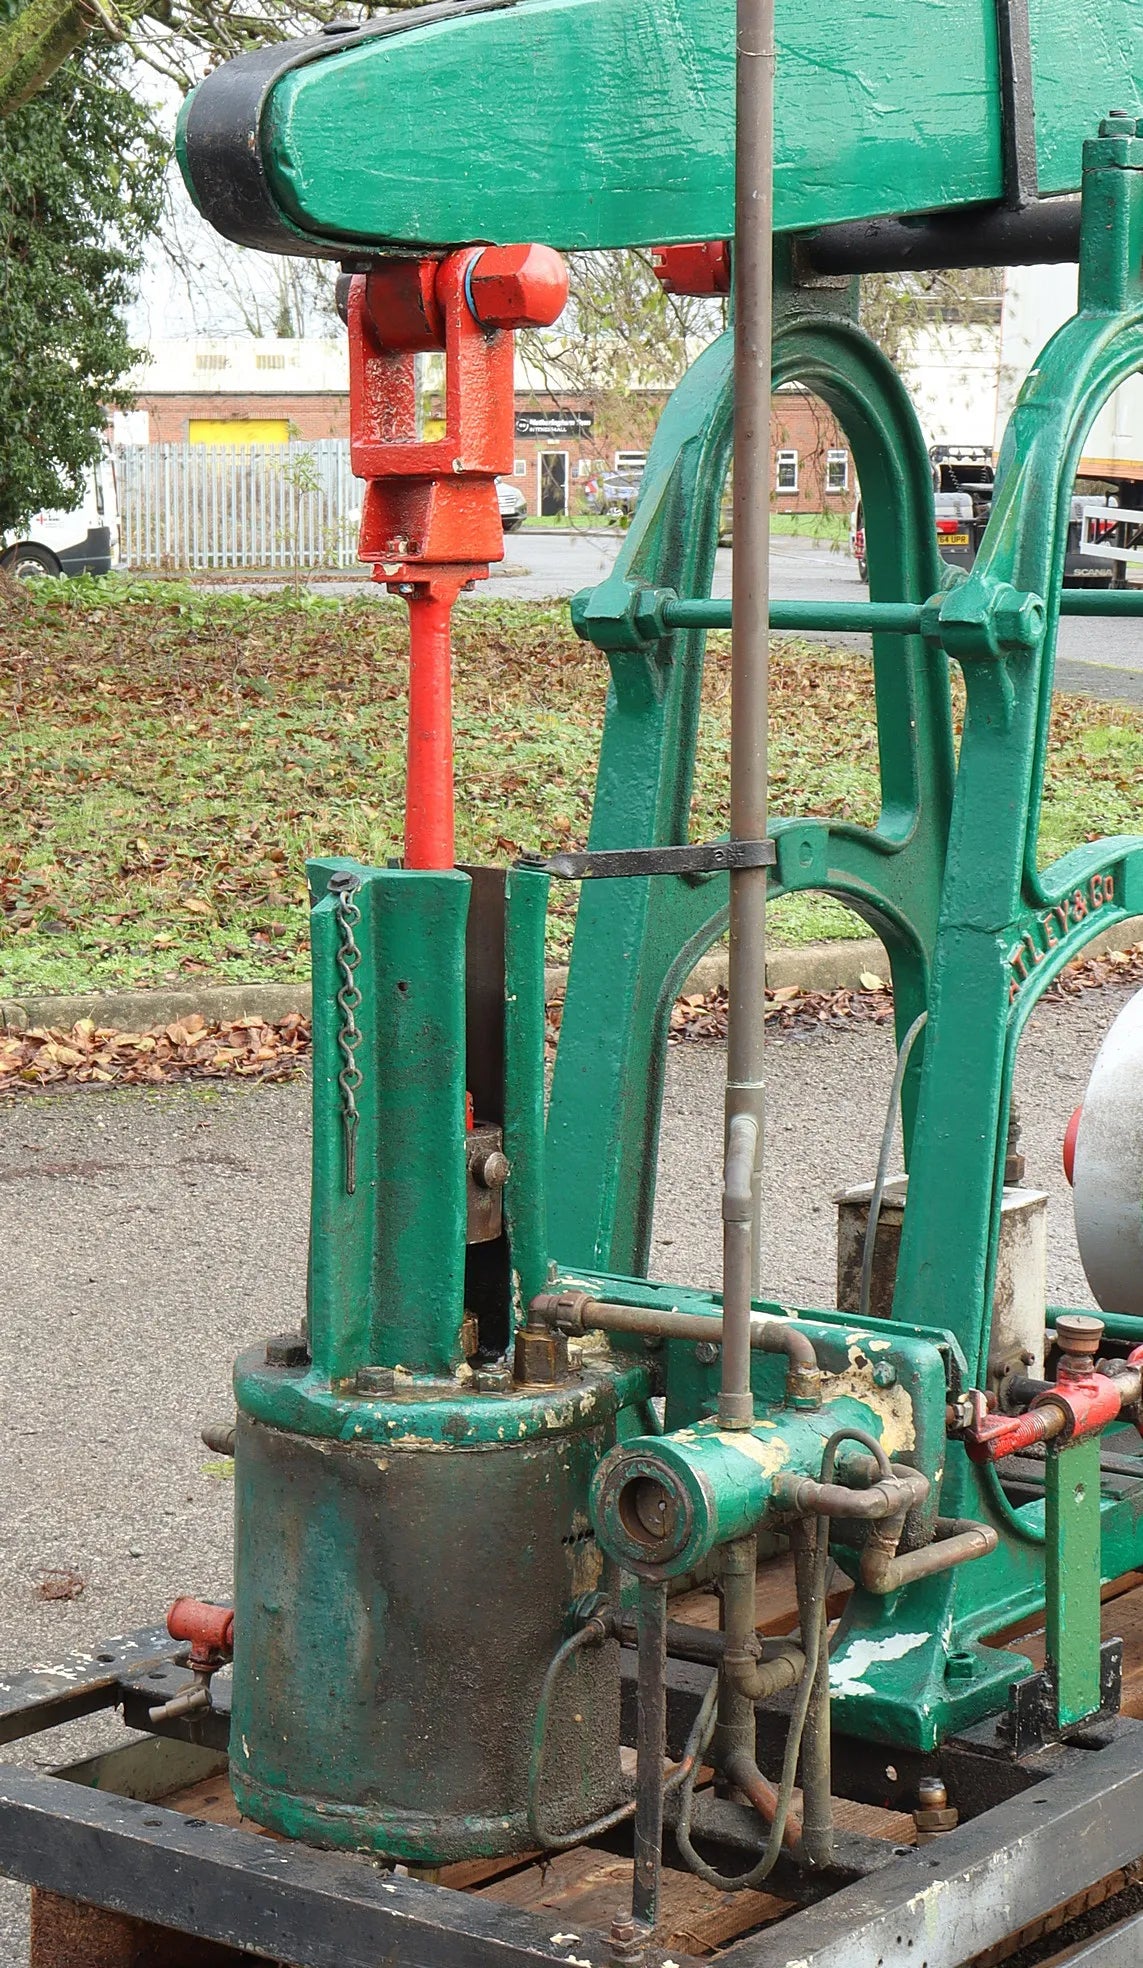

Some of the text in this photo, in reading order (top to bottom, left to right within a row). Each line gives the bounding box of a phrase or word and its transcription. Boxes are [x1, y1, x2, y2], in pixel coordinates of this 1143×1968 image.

[937, 535, 966, 543] 64 UPR
[1073, 568, 1112, 577] SCANIA
